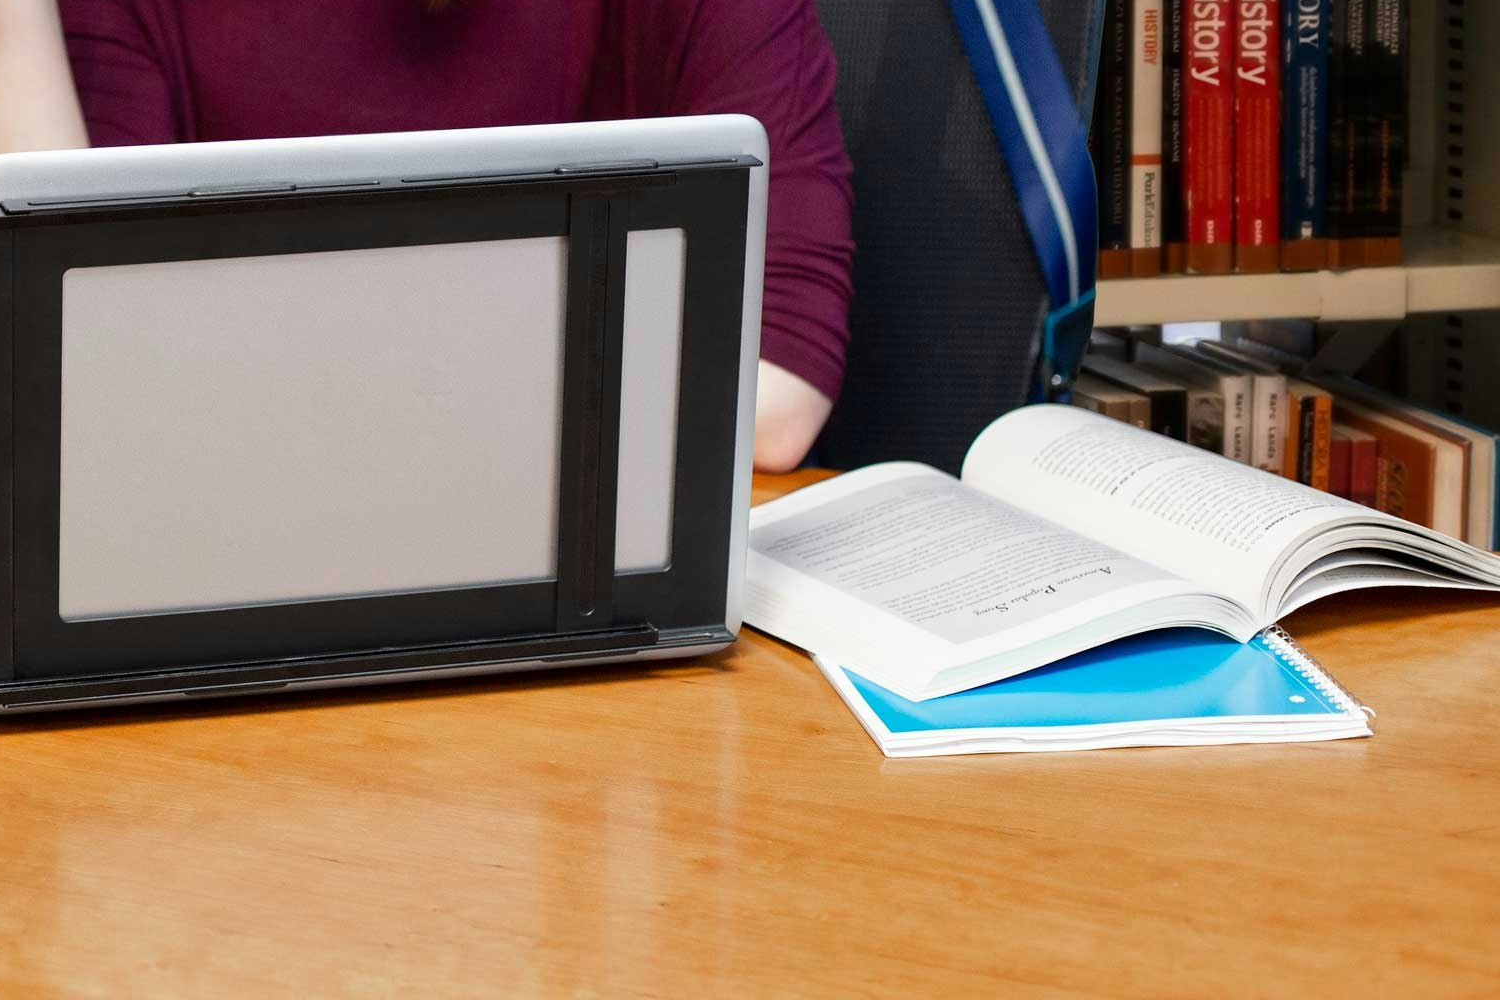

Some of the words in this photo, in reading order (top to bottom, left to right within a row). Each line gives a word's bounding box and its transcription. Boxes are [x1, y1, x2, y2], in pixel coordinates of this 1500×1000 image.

[1143, 8, 1158, 65] HISTORY
[1057, 566, 1111, 585] American
[1010, 585, 1056, 605] Popular
[973, 602, 1008, 616] Song
